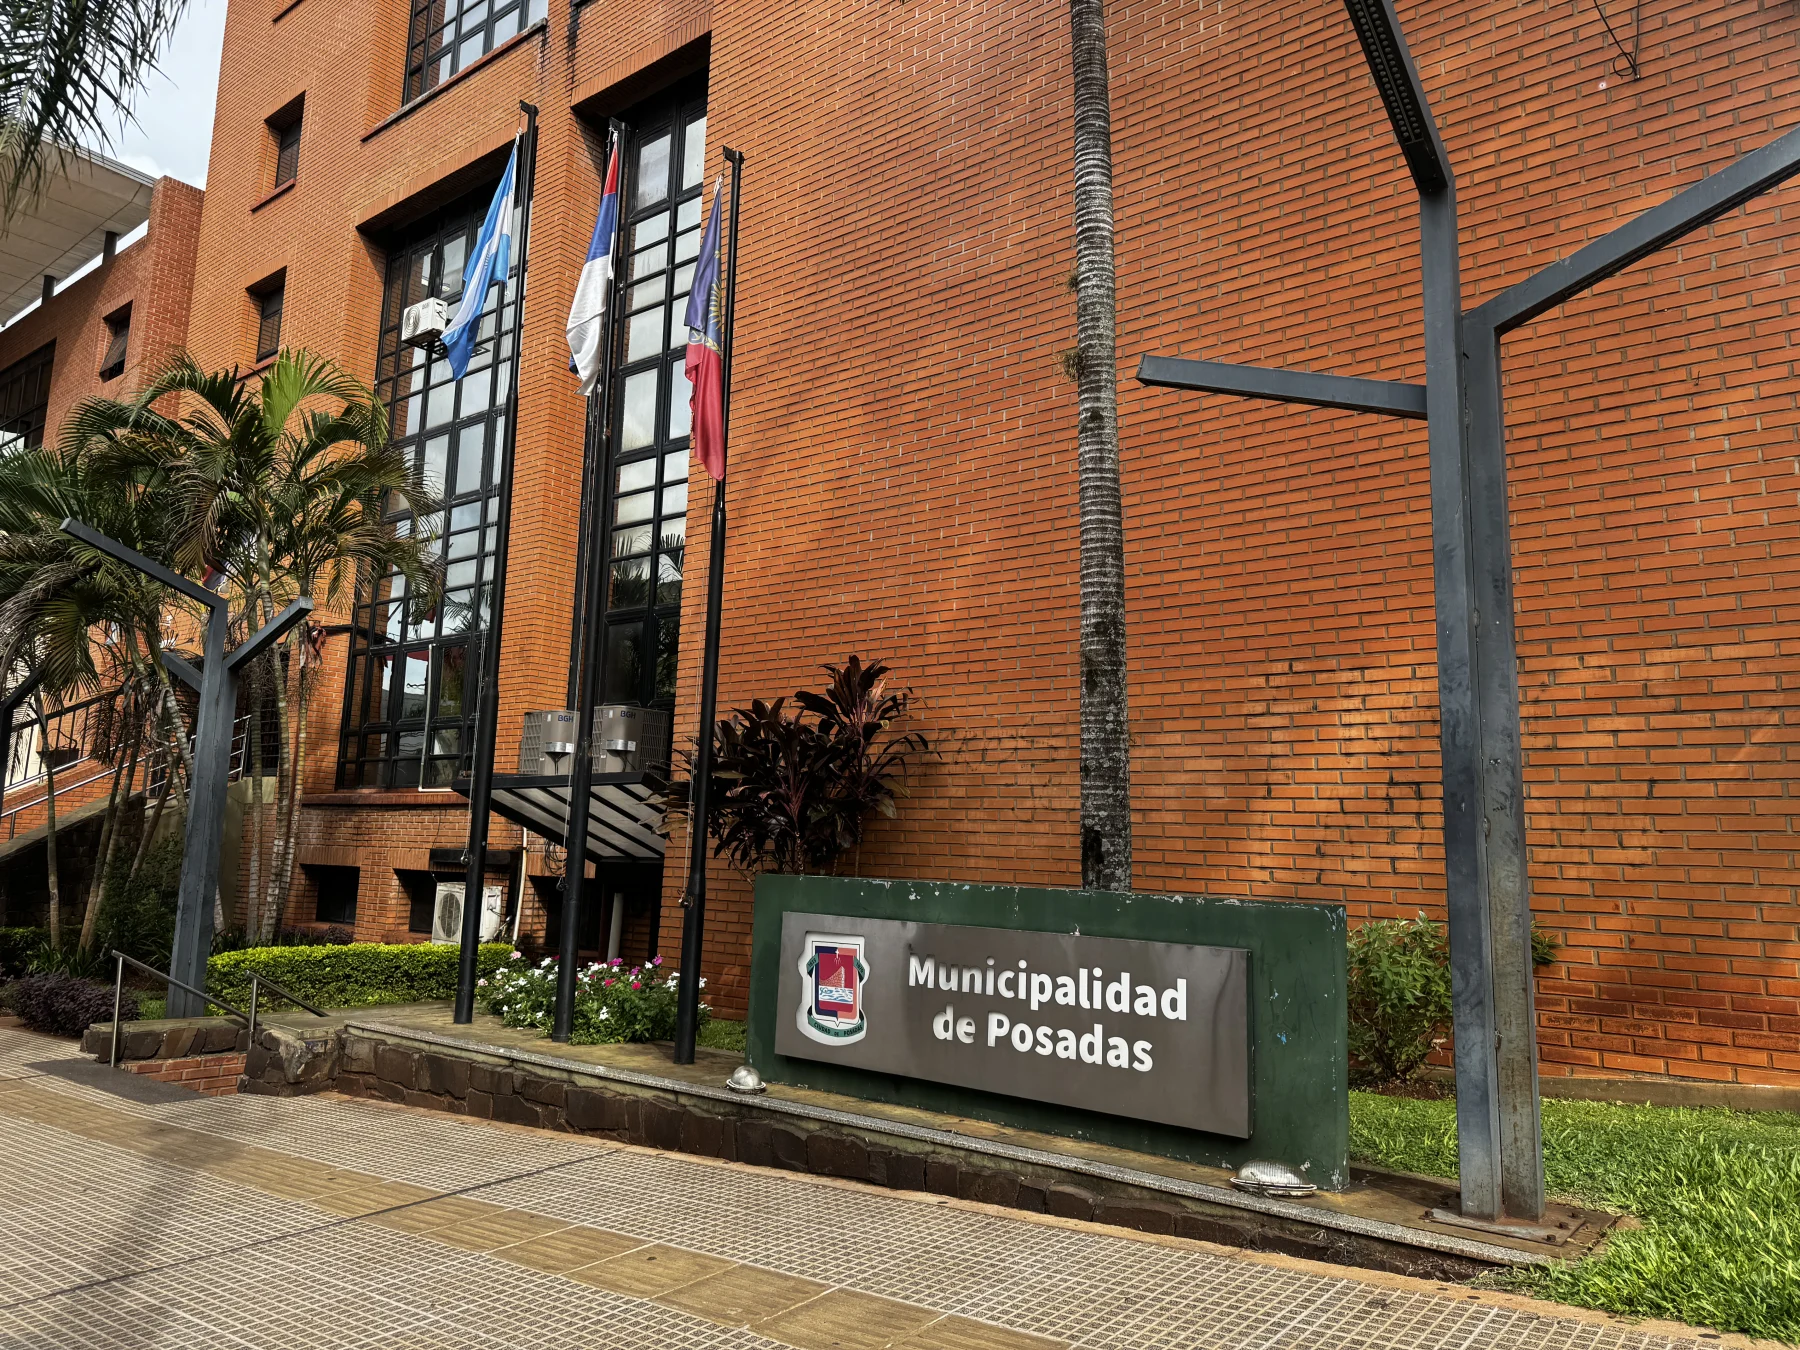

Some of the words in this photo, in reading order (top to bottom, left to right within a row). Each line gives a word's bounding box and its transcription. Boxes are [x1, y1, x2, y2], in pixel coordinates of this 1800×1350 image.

[558, 714, 574, 722] BGH
[620, 710, 636, 719] BGH
[908, 953, 1187, 1021] Municipalidad
[814, 1022, 831, 1034] CIUDAD
[843, 1025, 863, 1036] POSADAS
[932, 1002, 976, 1044] de
[987, 1011, 1153, 1072] Posadas
